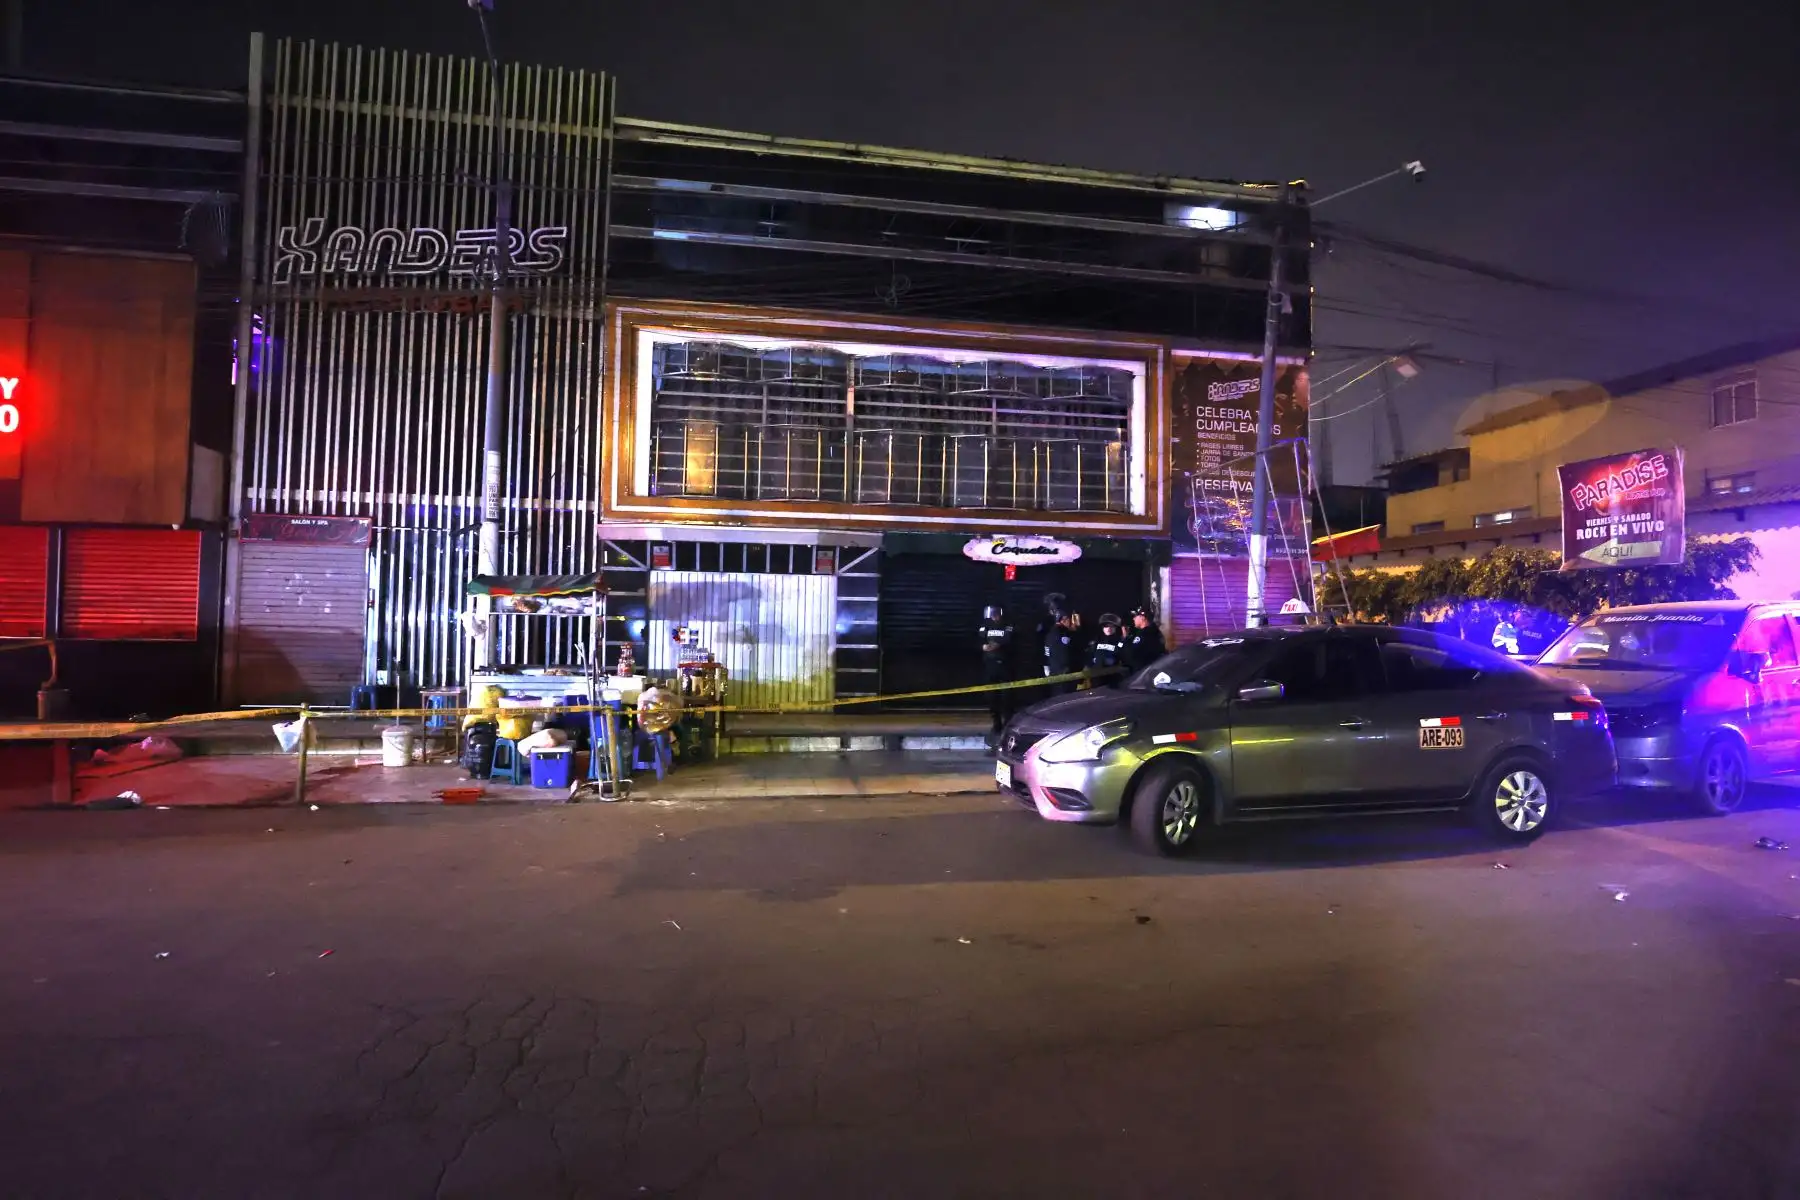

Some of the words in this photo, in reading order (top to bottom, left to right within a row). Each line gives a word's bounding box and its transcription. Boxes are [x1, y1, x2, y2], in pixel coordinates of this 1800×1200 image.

[272, 217, 568, 285] XANDERS
[1196, 406, 1252, 420] CELEBRA
[1196, 419, 1281, 436] CUMPLEAS
[1570, 455, 1669, 511] PARADISE
[1576, 526, 1607, 540] ROCK
[1610, 523, 1628, 536] EN
[1632, 520, 1665, 534] VIVO
[1586, 517, 1611, 527] VIERNES
[1421, 728, 1463, 747] ARE-093
